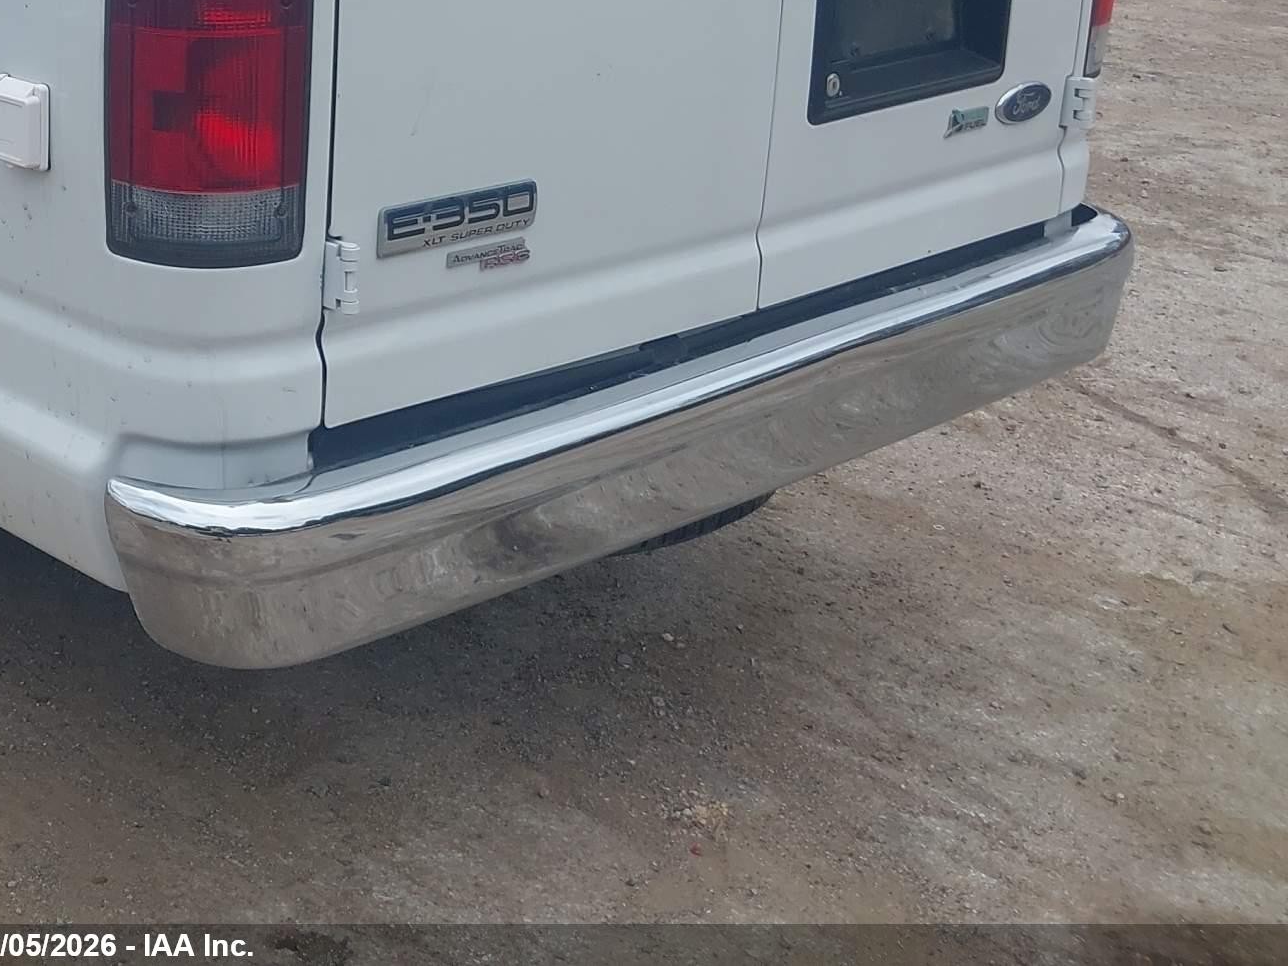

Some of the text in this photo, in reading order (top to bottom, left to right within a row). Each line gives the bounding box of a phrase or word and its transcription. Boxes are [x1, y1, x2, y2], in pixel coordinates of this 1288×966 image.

[423, 218, 530, 248] XLT SUPER DUTY
